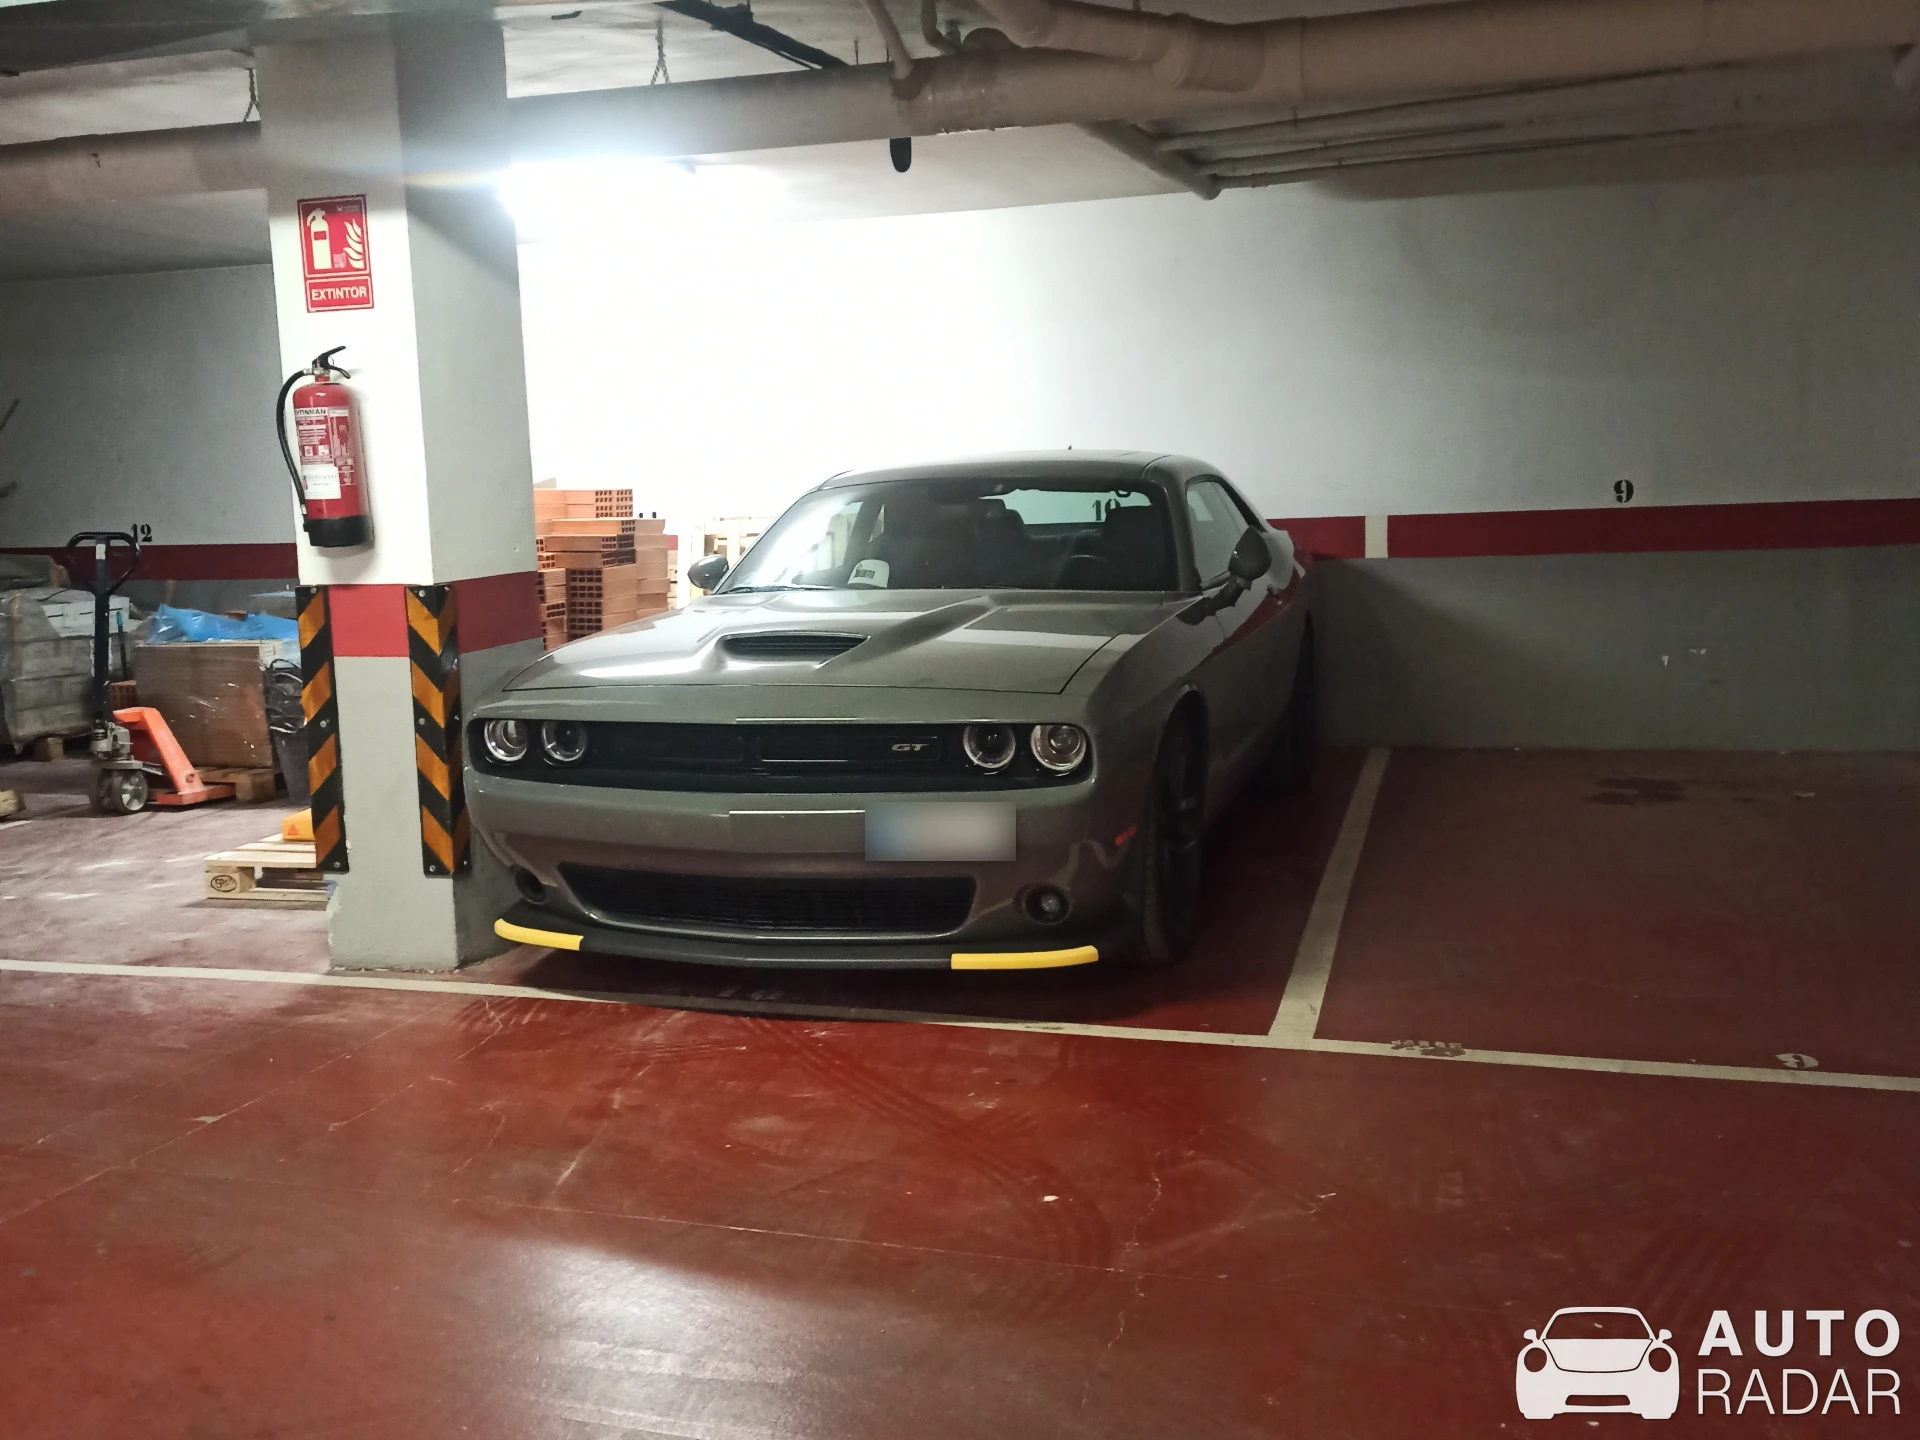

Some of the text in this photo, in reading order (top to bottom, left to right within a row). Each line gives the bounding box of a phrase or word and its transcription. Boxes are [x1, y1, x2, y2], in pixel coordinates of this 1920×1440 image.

[311, 286, 368, 301] EXTINTOR
[1614, 479, 1634, 503] 9
[131, 523, 152, 542] 12
[891, 743, 929, 751] GT
